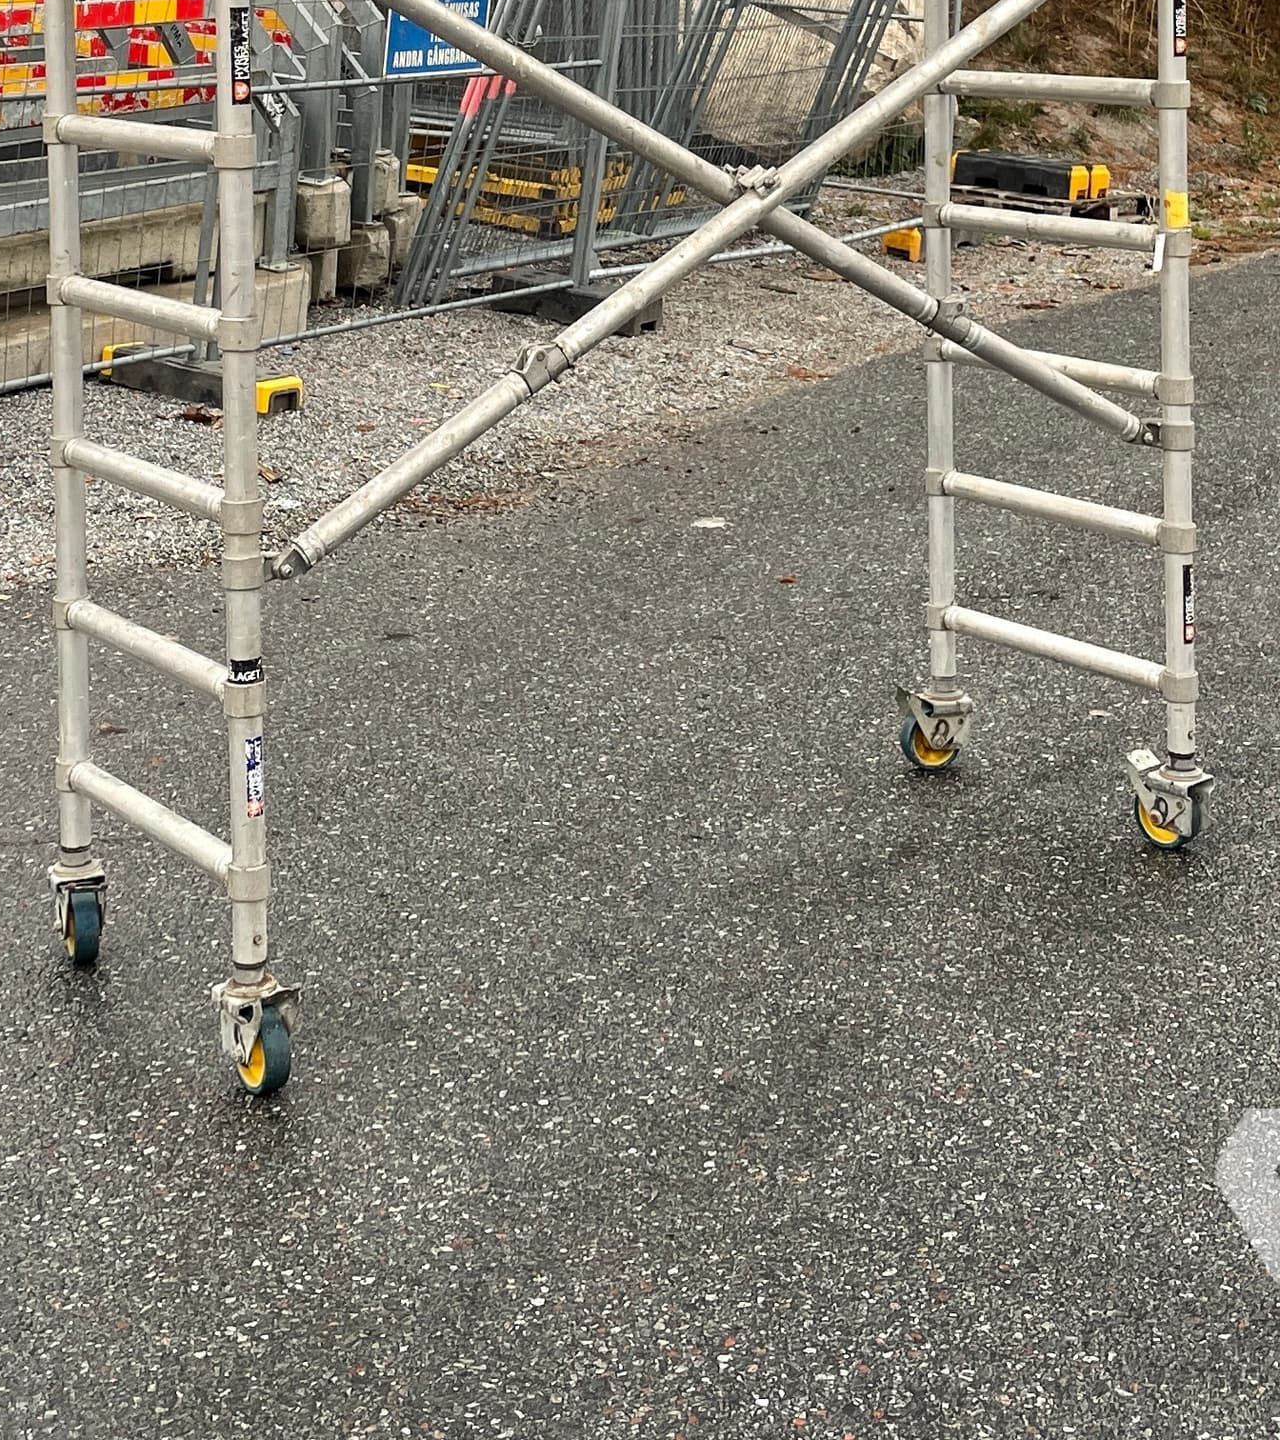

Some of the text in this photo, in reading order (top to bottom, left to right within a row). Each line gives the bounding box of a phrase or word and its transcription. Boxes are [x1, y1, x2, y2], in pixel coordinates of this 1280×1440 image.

[241, 11, 250, 80] LANDSLAGET
[392, 50, 423, 68] ANDRA
[234, 46, 243, 80] HYRES
